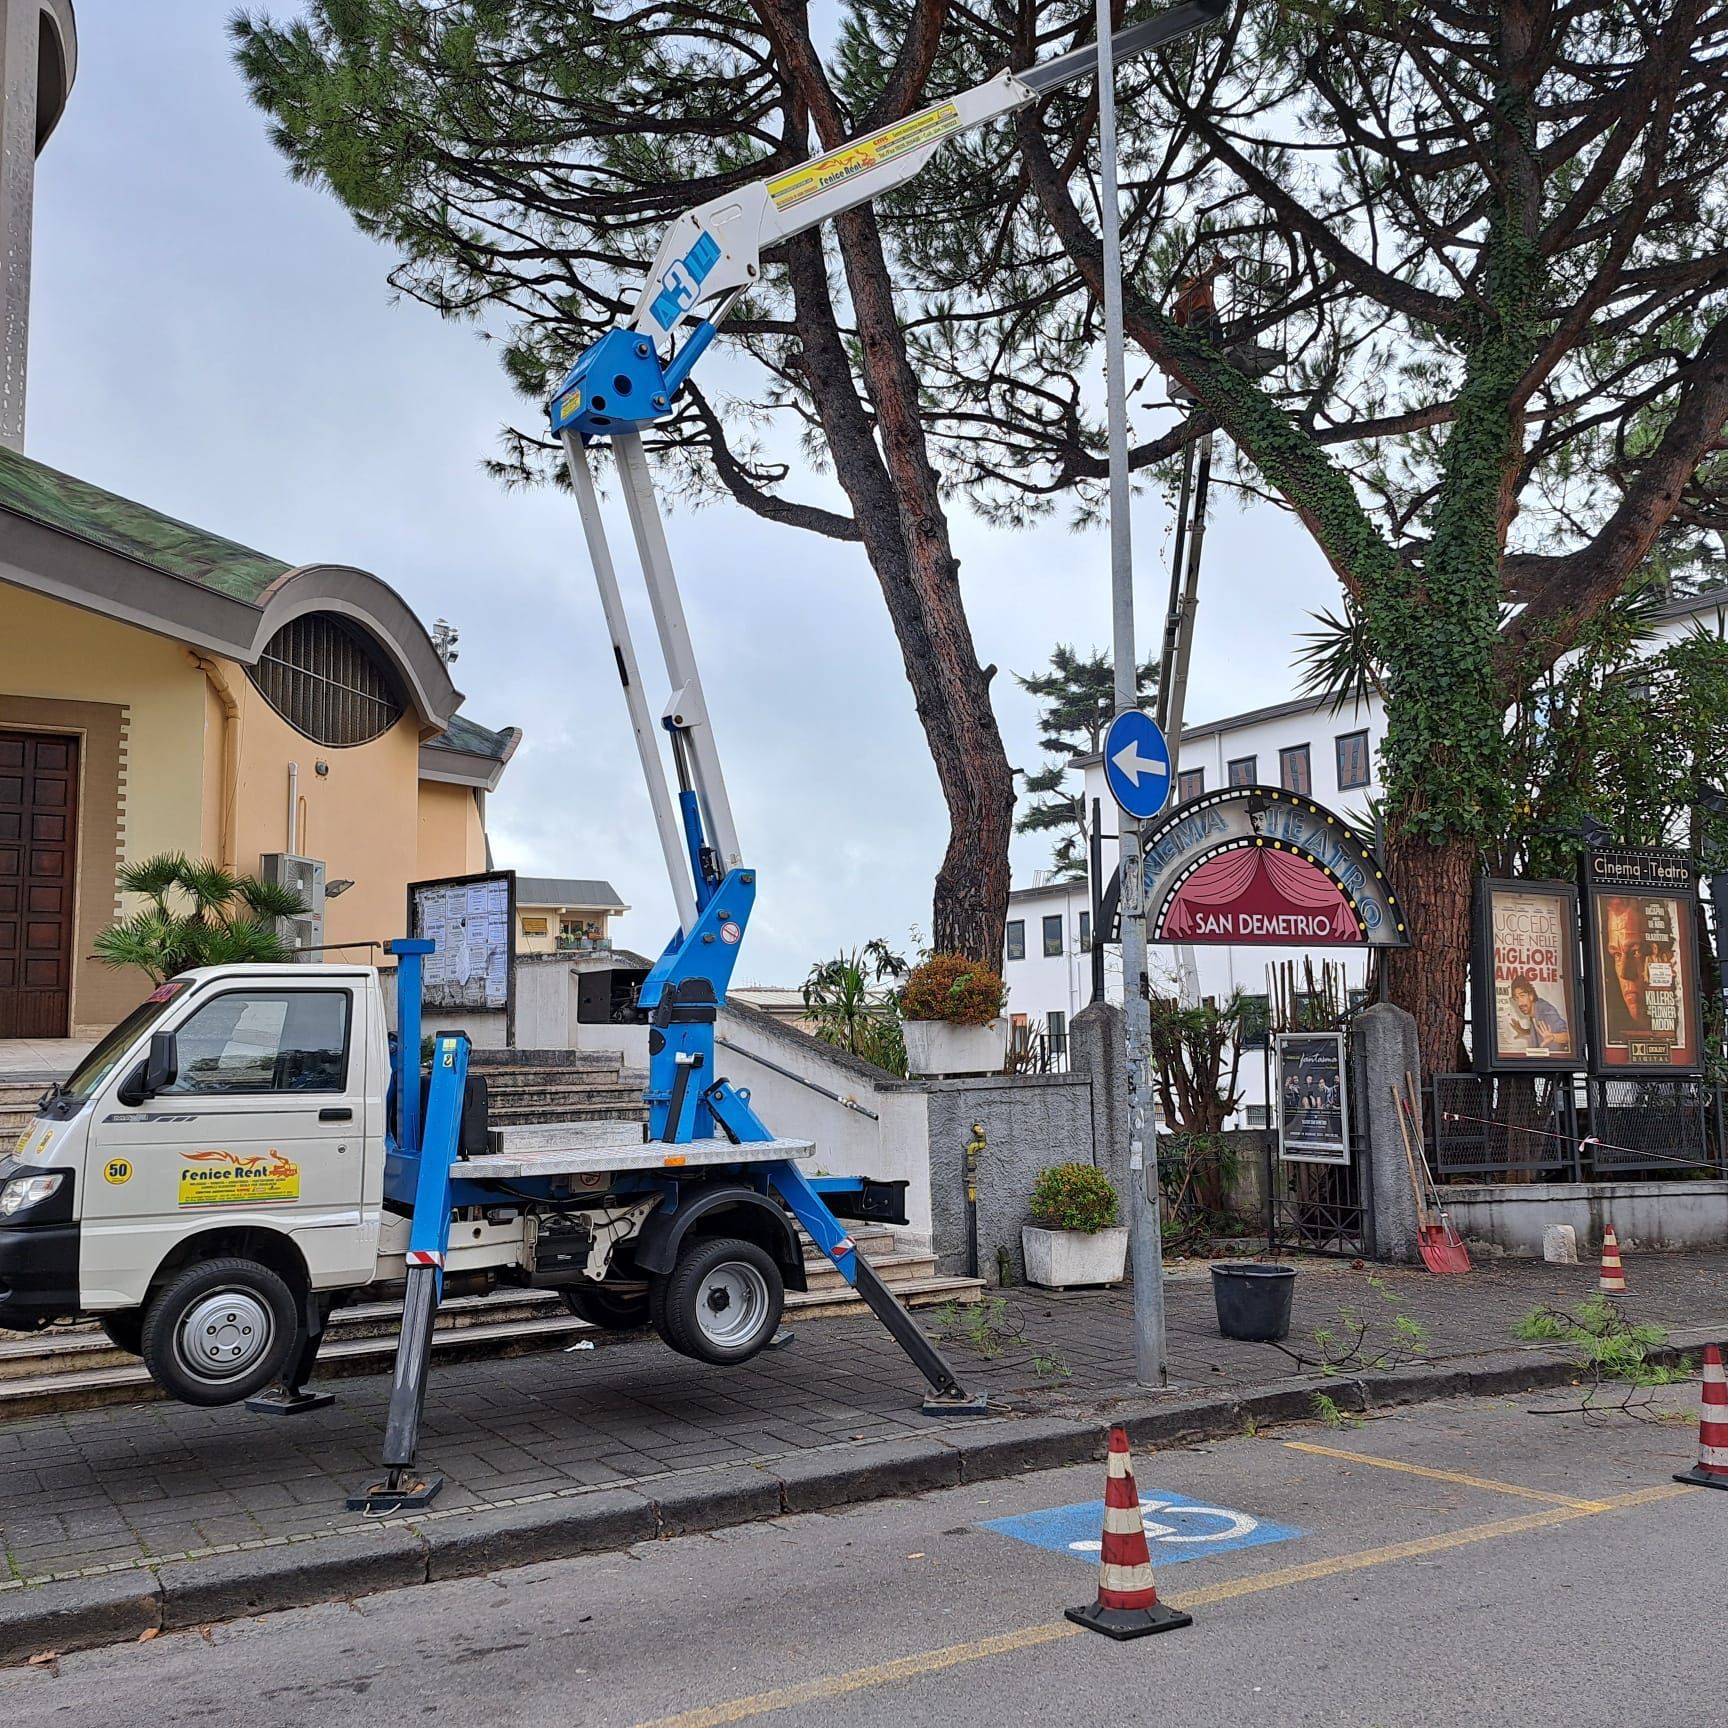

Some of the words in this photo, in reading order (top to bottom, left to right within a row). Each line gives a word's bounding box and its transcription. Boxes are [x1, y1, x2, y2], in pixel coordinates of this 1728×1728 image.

[819, 172, 845, 186] Fenice
[844, 161, 863, 175] Rent
[649, 231, 721, 332] A314
[1143, 806, 1229, 889] NEMA
[1265, 802, 1383, 929] TEATRO
[1594, 858, 1640, 876] Cinema
[1650, 862, 1688, 879] Teatro
[1196, 912, 1233, 934] SAN
[1238, 914, 1331, 936] DEMETRIO
[1495, 913, 1557, 934] UCCEDE
[1495, 933, 1525, 946] NCHE
[1529, 935, 1558, 948] NELLE
[1645, 990, 1675, 1005] KILLERS
[1652, 1018, 1675, 1031] MOON
[109, 1163, 128, 1177] 50
[181, 1168, 232, 1181] Fenice
[234, 1165, 268, 1179] Rent
